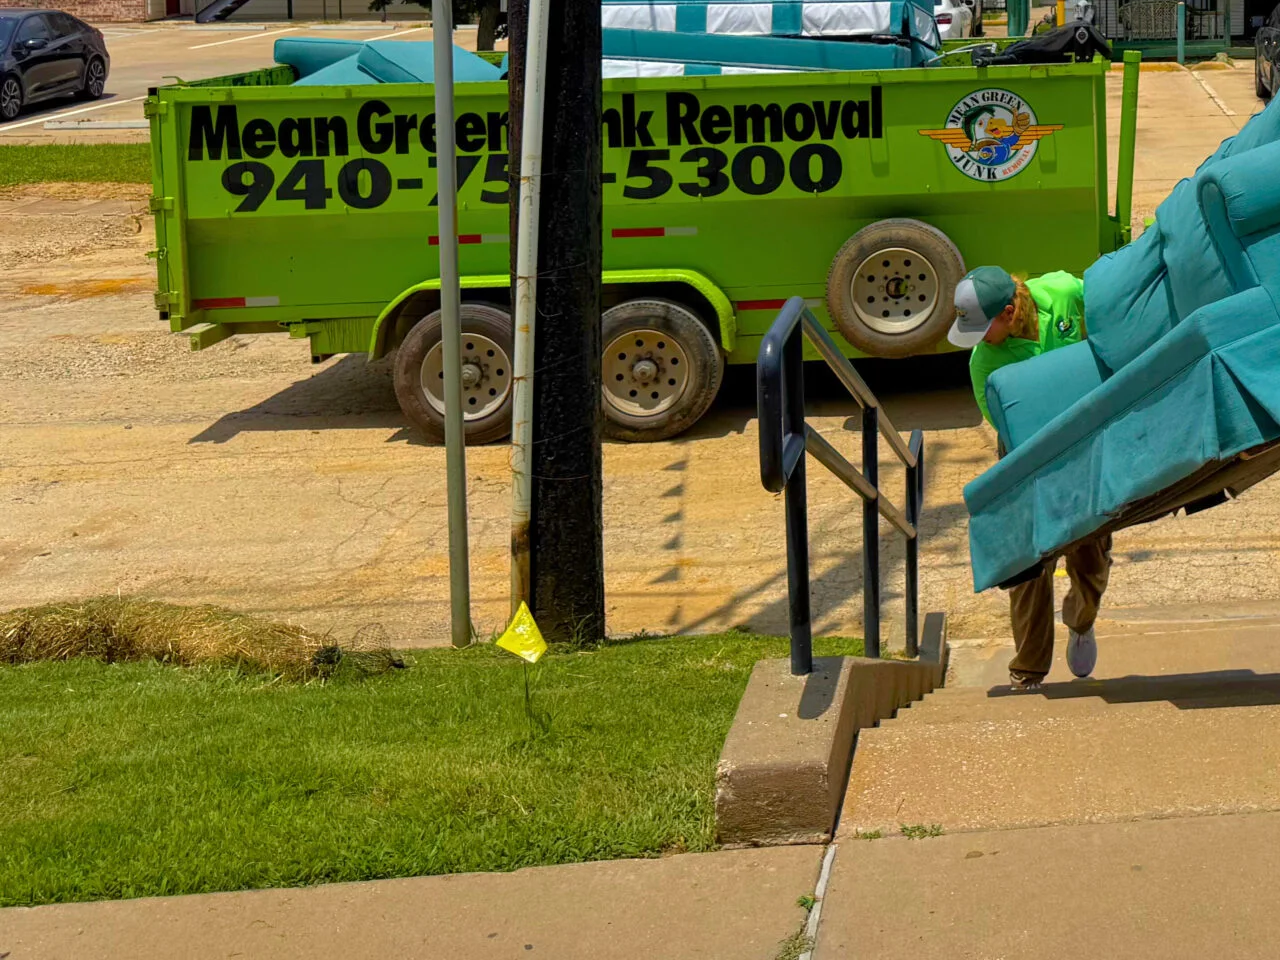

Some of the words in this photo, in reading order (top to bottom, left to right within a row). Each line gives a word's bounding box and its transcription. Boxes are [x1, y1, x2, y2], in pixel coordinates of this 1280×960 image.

[188, 105, 348, 161] Mean
[666, 86, 882, 146] Removal
[948, 95, 980, 126] MEAN
[981, 91, 1025, 112] GREEN
[221, 143, 842, 213] 940-75-5300
[953, 154, 998, 180] JUNK
[1002, 150, 1030, 176] REMOVAL
